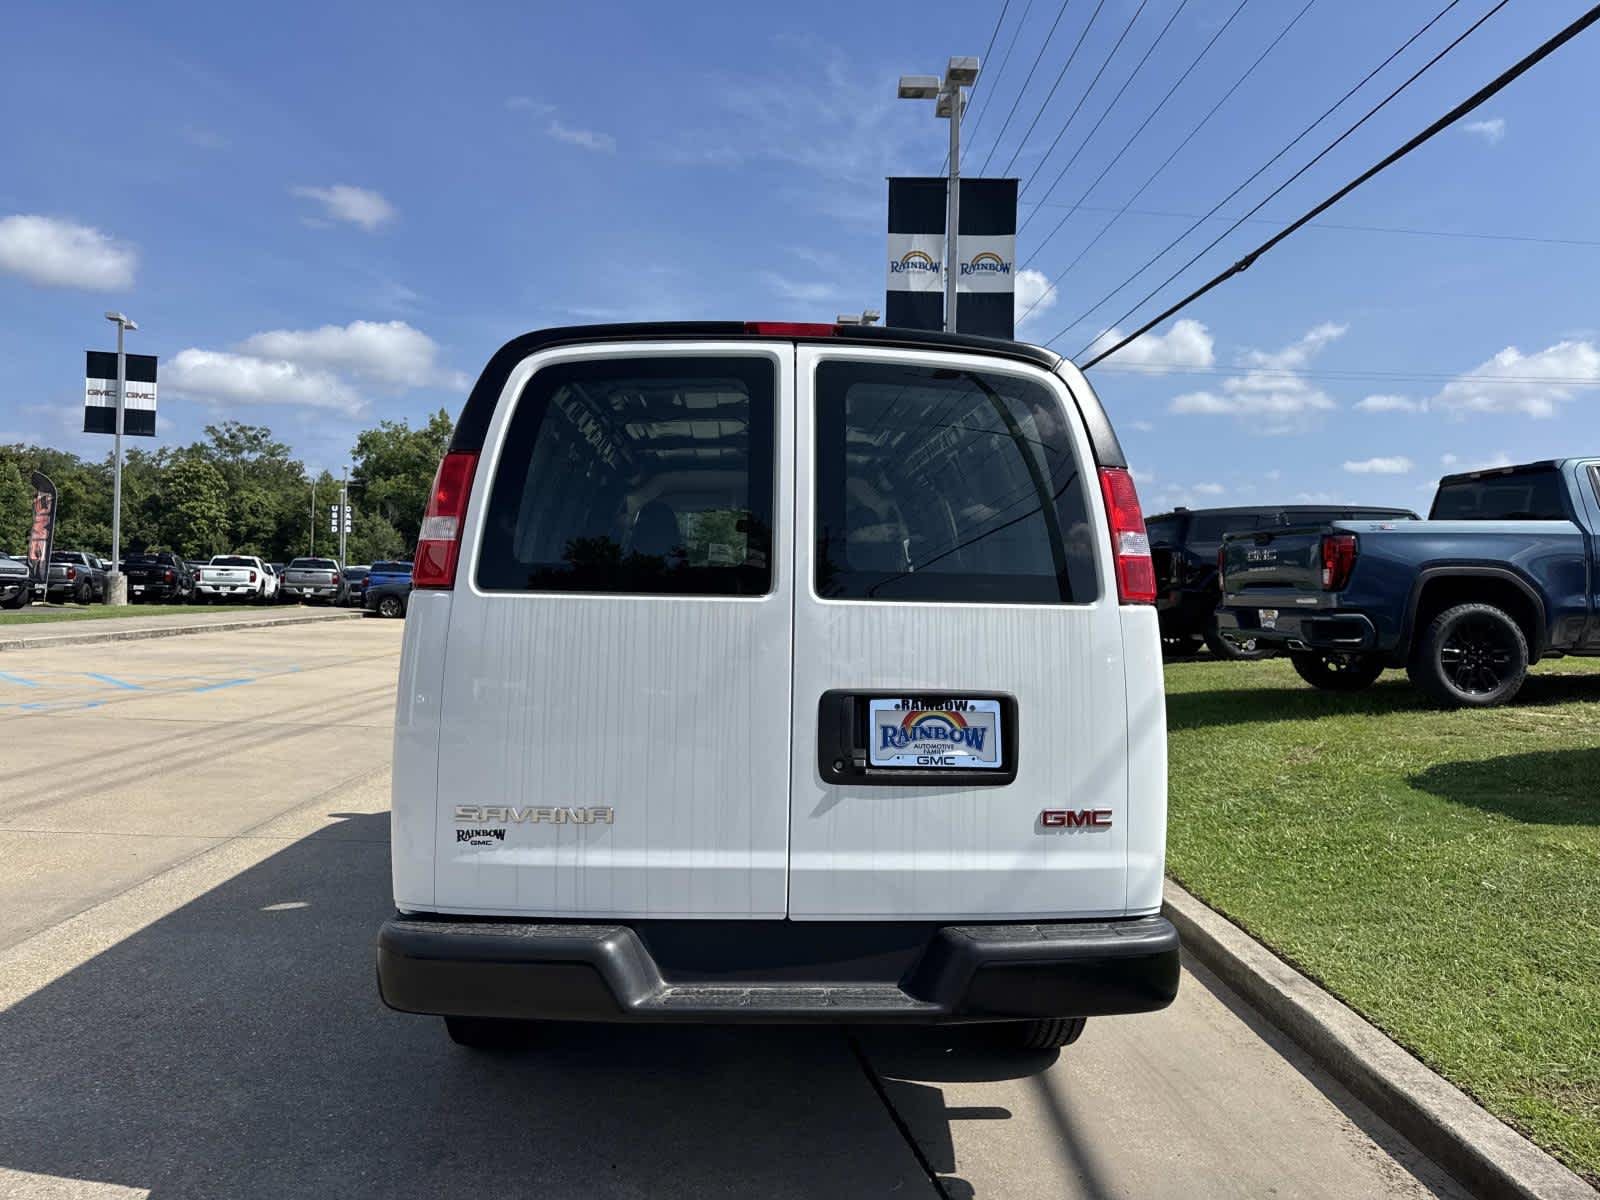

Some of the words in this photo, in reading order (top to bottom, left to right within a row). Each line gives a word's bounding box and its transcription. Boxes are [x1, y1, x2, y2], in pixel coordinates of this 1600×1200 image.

[891, 260, 941, 274] RAINBOW
[960, 262, 1012, 275] RAINBOW
[87, 389, 116, 397] GMC
[126, 391, 155, 400] GMC
[1247, 549, 1277, 561] GMC
[880, 725, 987, 751] RAINBOW
[916, 756, 955, 765] GMC
[455, 805, 614, 824] SAVANA
[1040, 808, 1113, 827] GMC
[456, 829, 506, 842] RAINBOW
